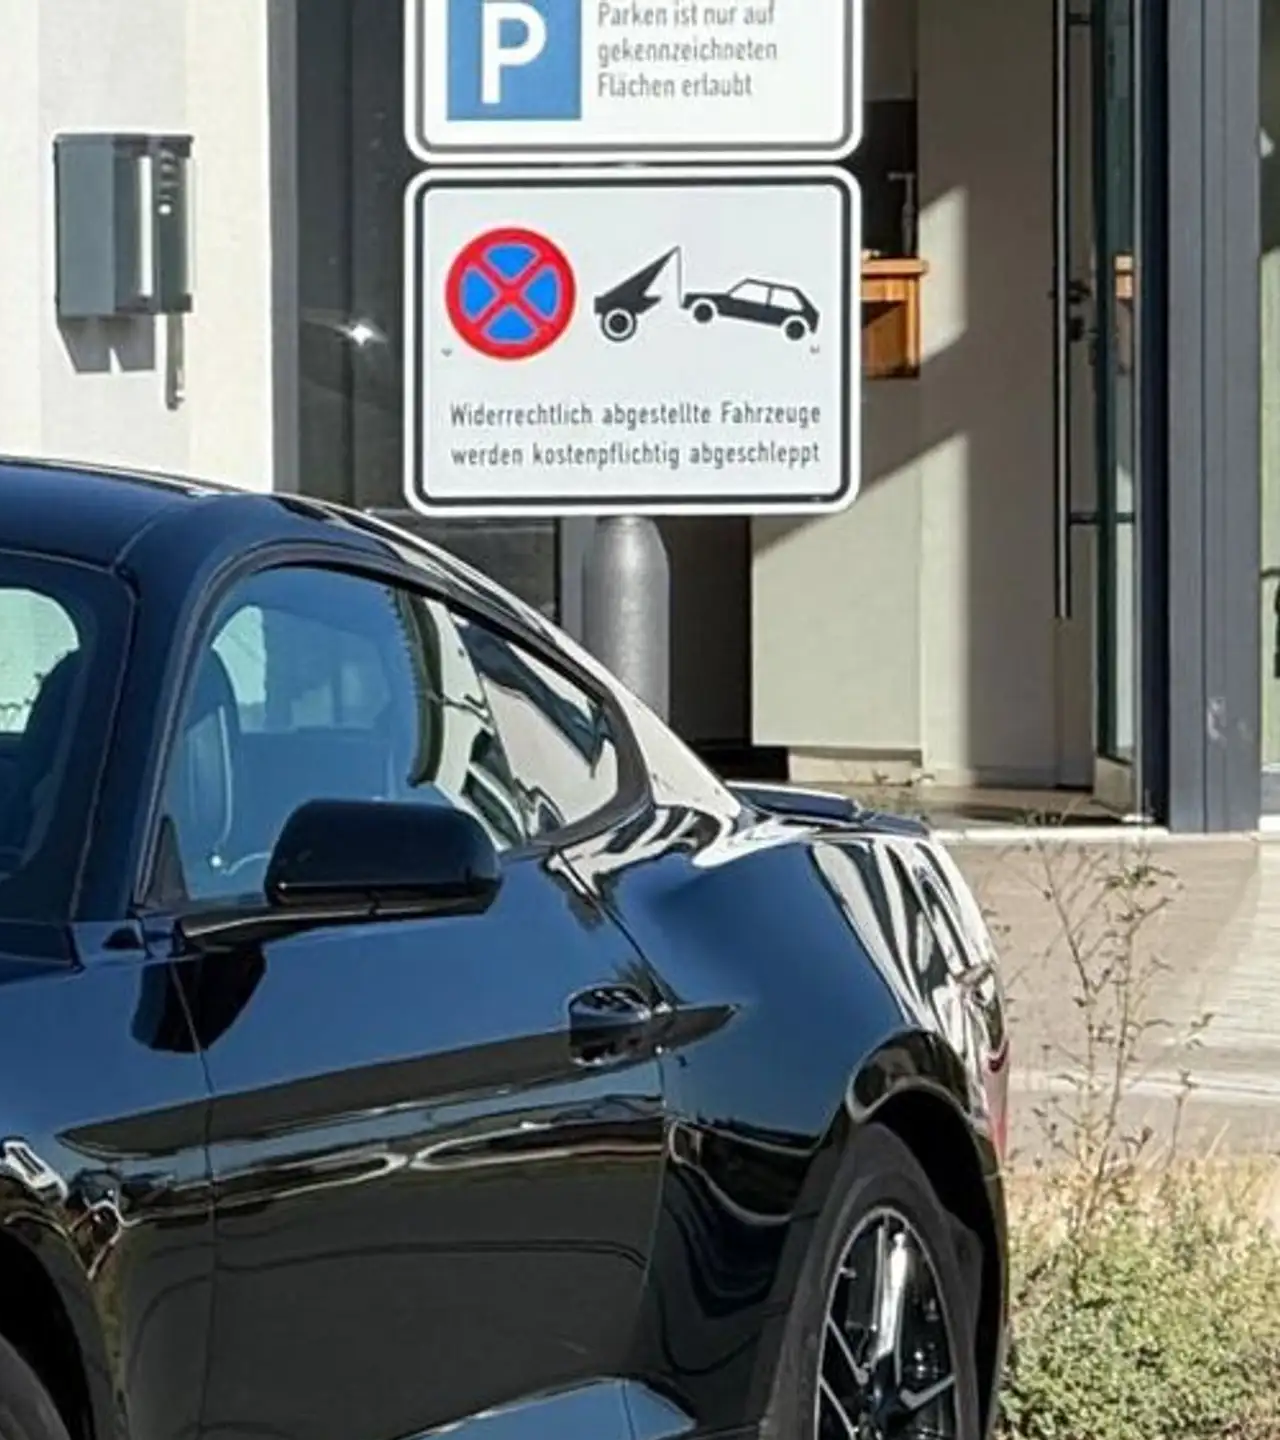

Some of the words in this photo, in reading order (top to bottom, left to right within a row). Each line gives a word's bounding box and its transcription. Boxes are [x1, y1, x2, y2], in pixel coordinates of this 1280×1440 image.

[597, 2, 668, 26] Parken
[673, 3, 697, 26] ist
[703, 7, 736, 26] nur
[743, 3, 776, 26] auf
[481, 1, 547, 104] P
[597, 37, 778, 66] gekennzeichneten
[597, 72, 676, 97] Flächen
[681, 73, 752, 97] erlaubt
[450, 403, 593, 426] Widerrechtlich
[602, 403, 711, 430] abgestellte
[720, 402, 821, 429] Fahrzeuge
[451, 444, 523, 466] werden
[532, 442, 680, 469] kostenpflichtig
[689, 442, 820, 469] abgeschleppt
